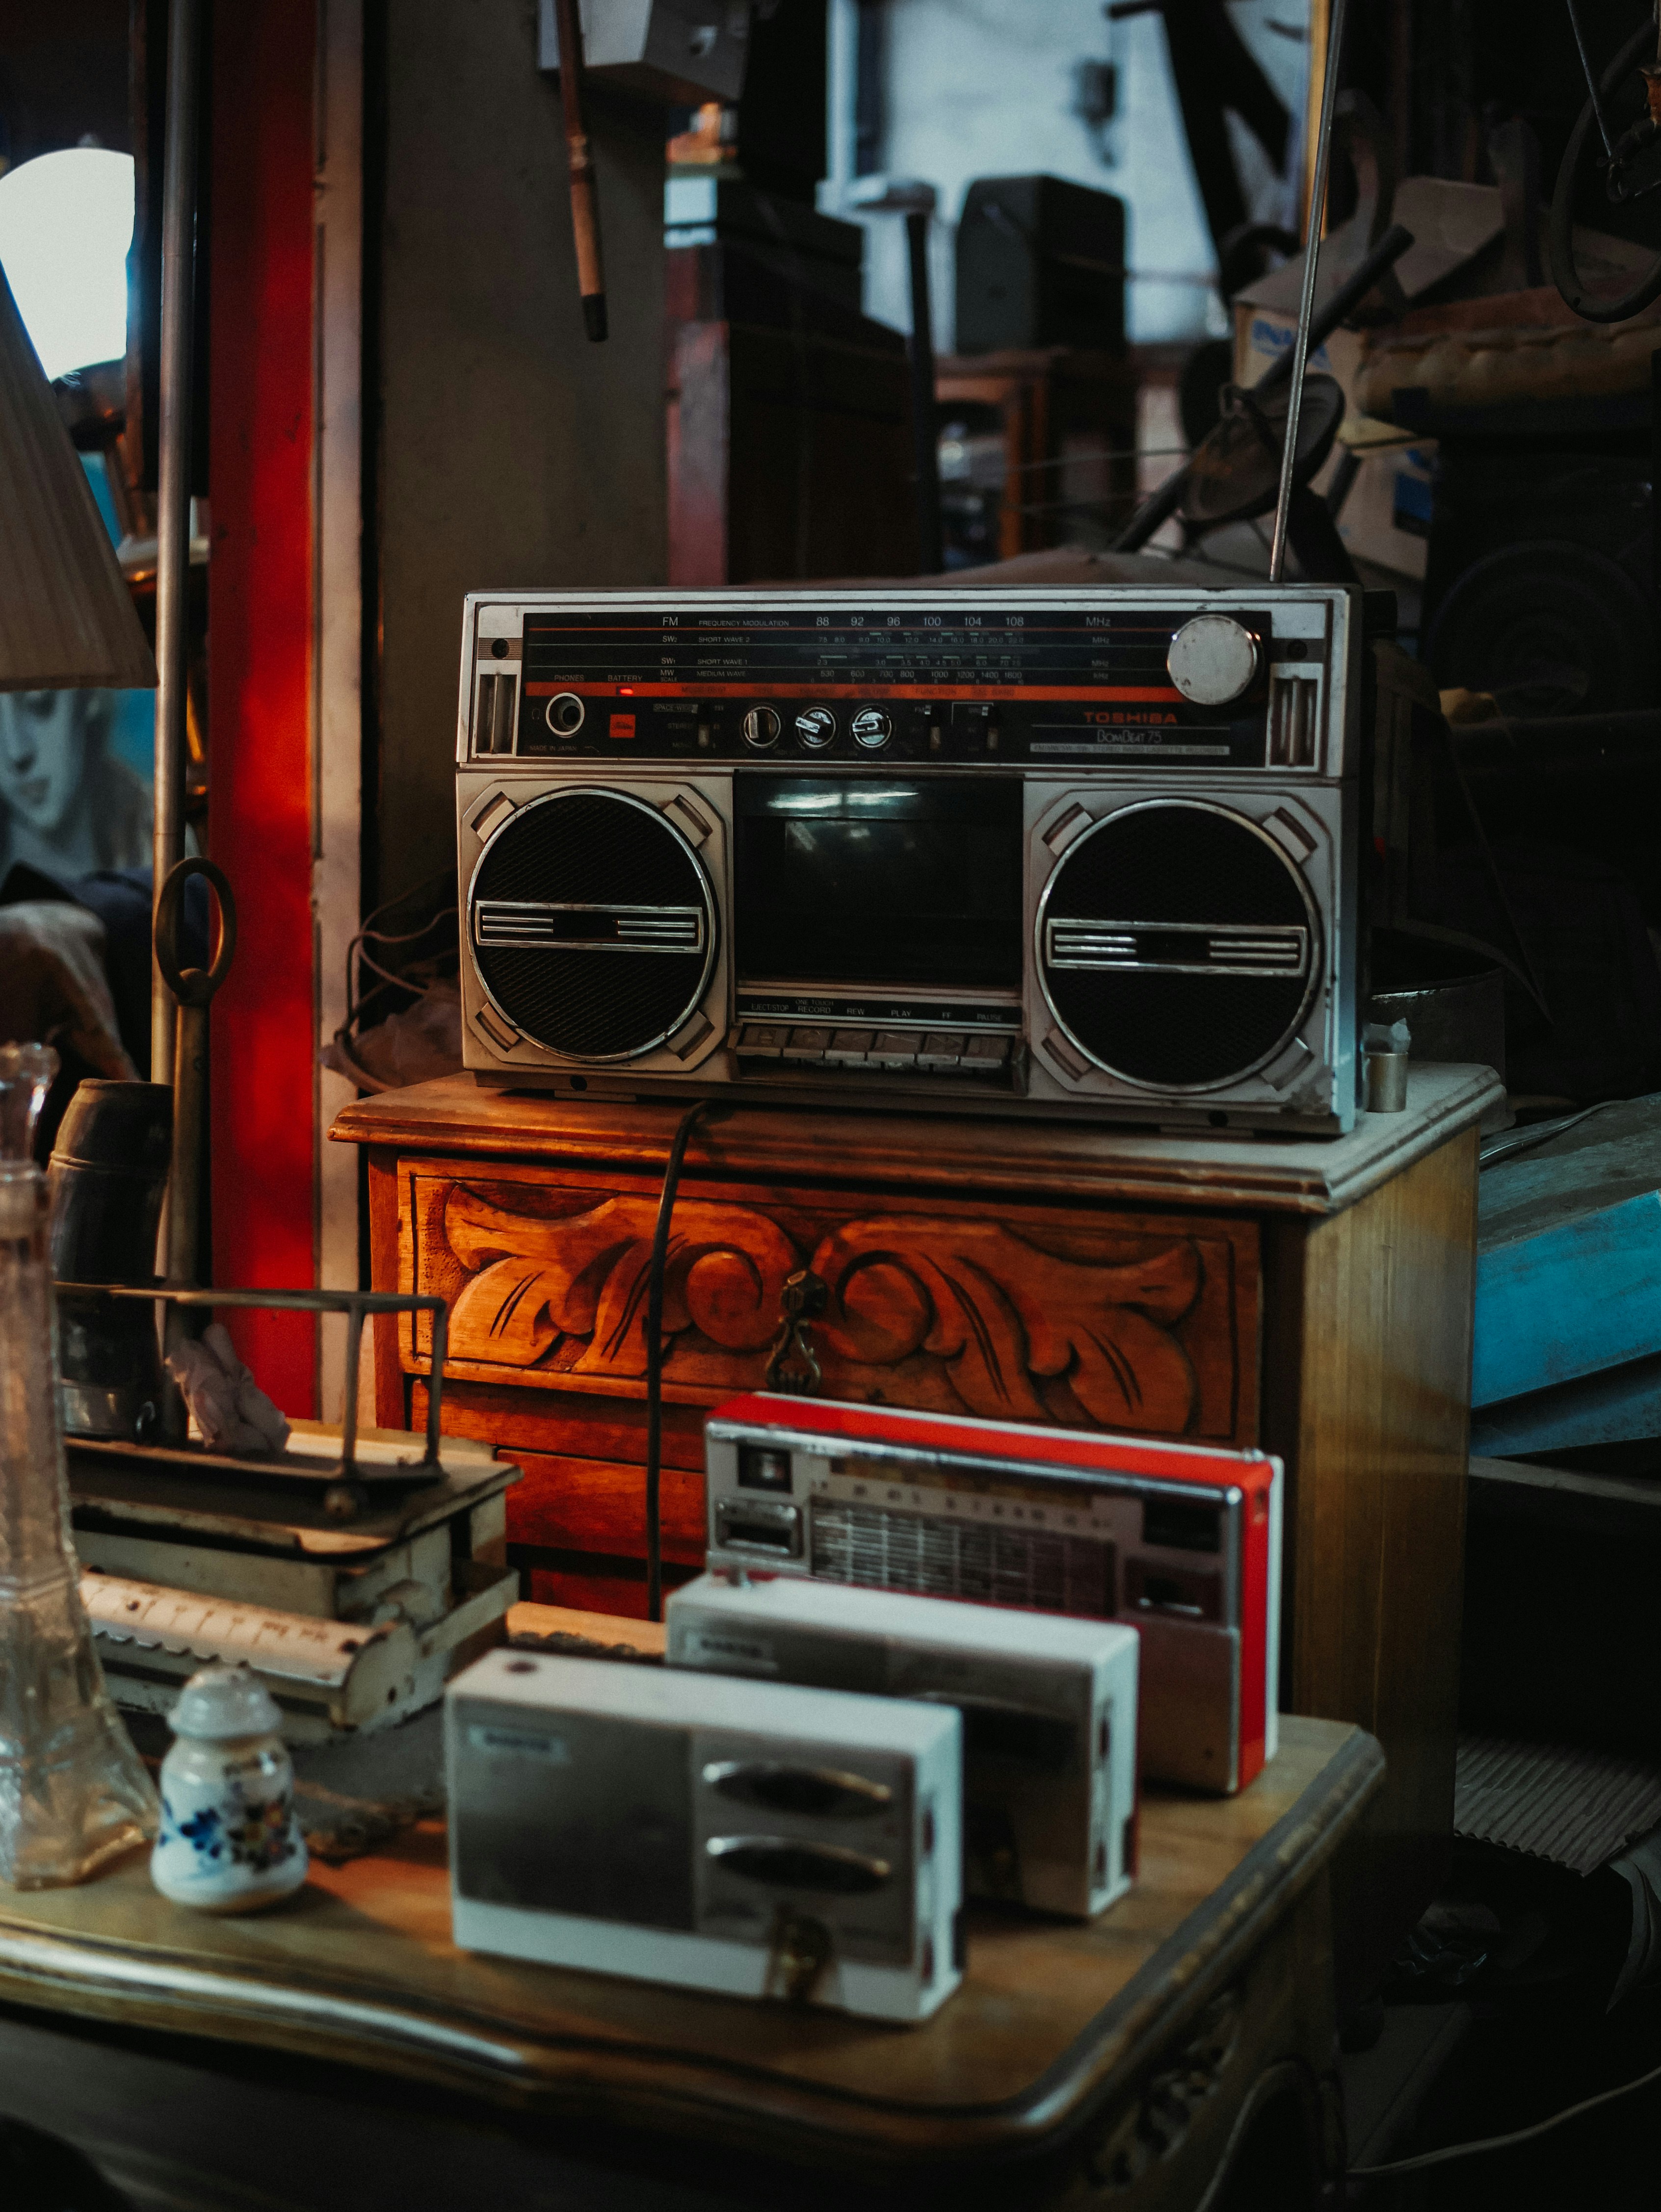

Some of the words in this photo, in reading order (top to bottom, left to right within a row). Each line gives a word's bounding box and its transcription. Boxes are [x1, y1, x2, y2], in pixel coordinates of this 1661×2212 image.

[662, 616, 678, 626] FM
[816, 617, 829, 626] 88
[850, 617, 864, 626] 92
[887, 617, 900, 626] 96
[924, 617, 941, 626] 100
[964, 617, 982, 626] 104
[1006, 617, 1024, 627] 108
[1086, 616, 1111, 627] MHz
[1083, 711, 1177, 725] TOSHIBA
[798, 1006, 831, 1014] RECORD
[846, 1007, 865, 1015] REW
[891, 1009, 912, 1017] PLAY
[976, 1013, 1002, 1022] PAUSE
